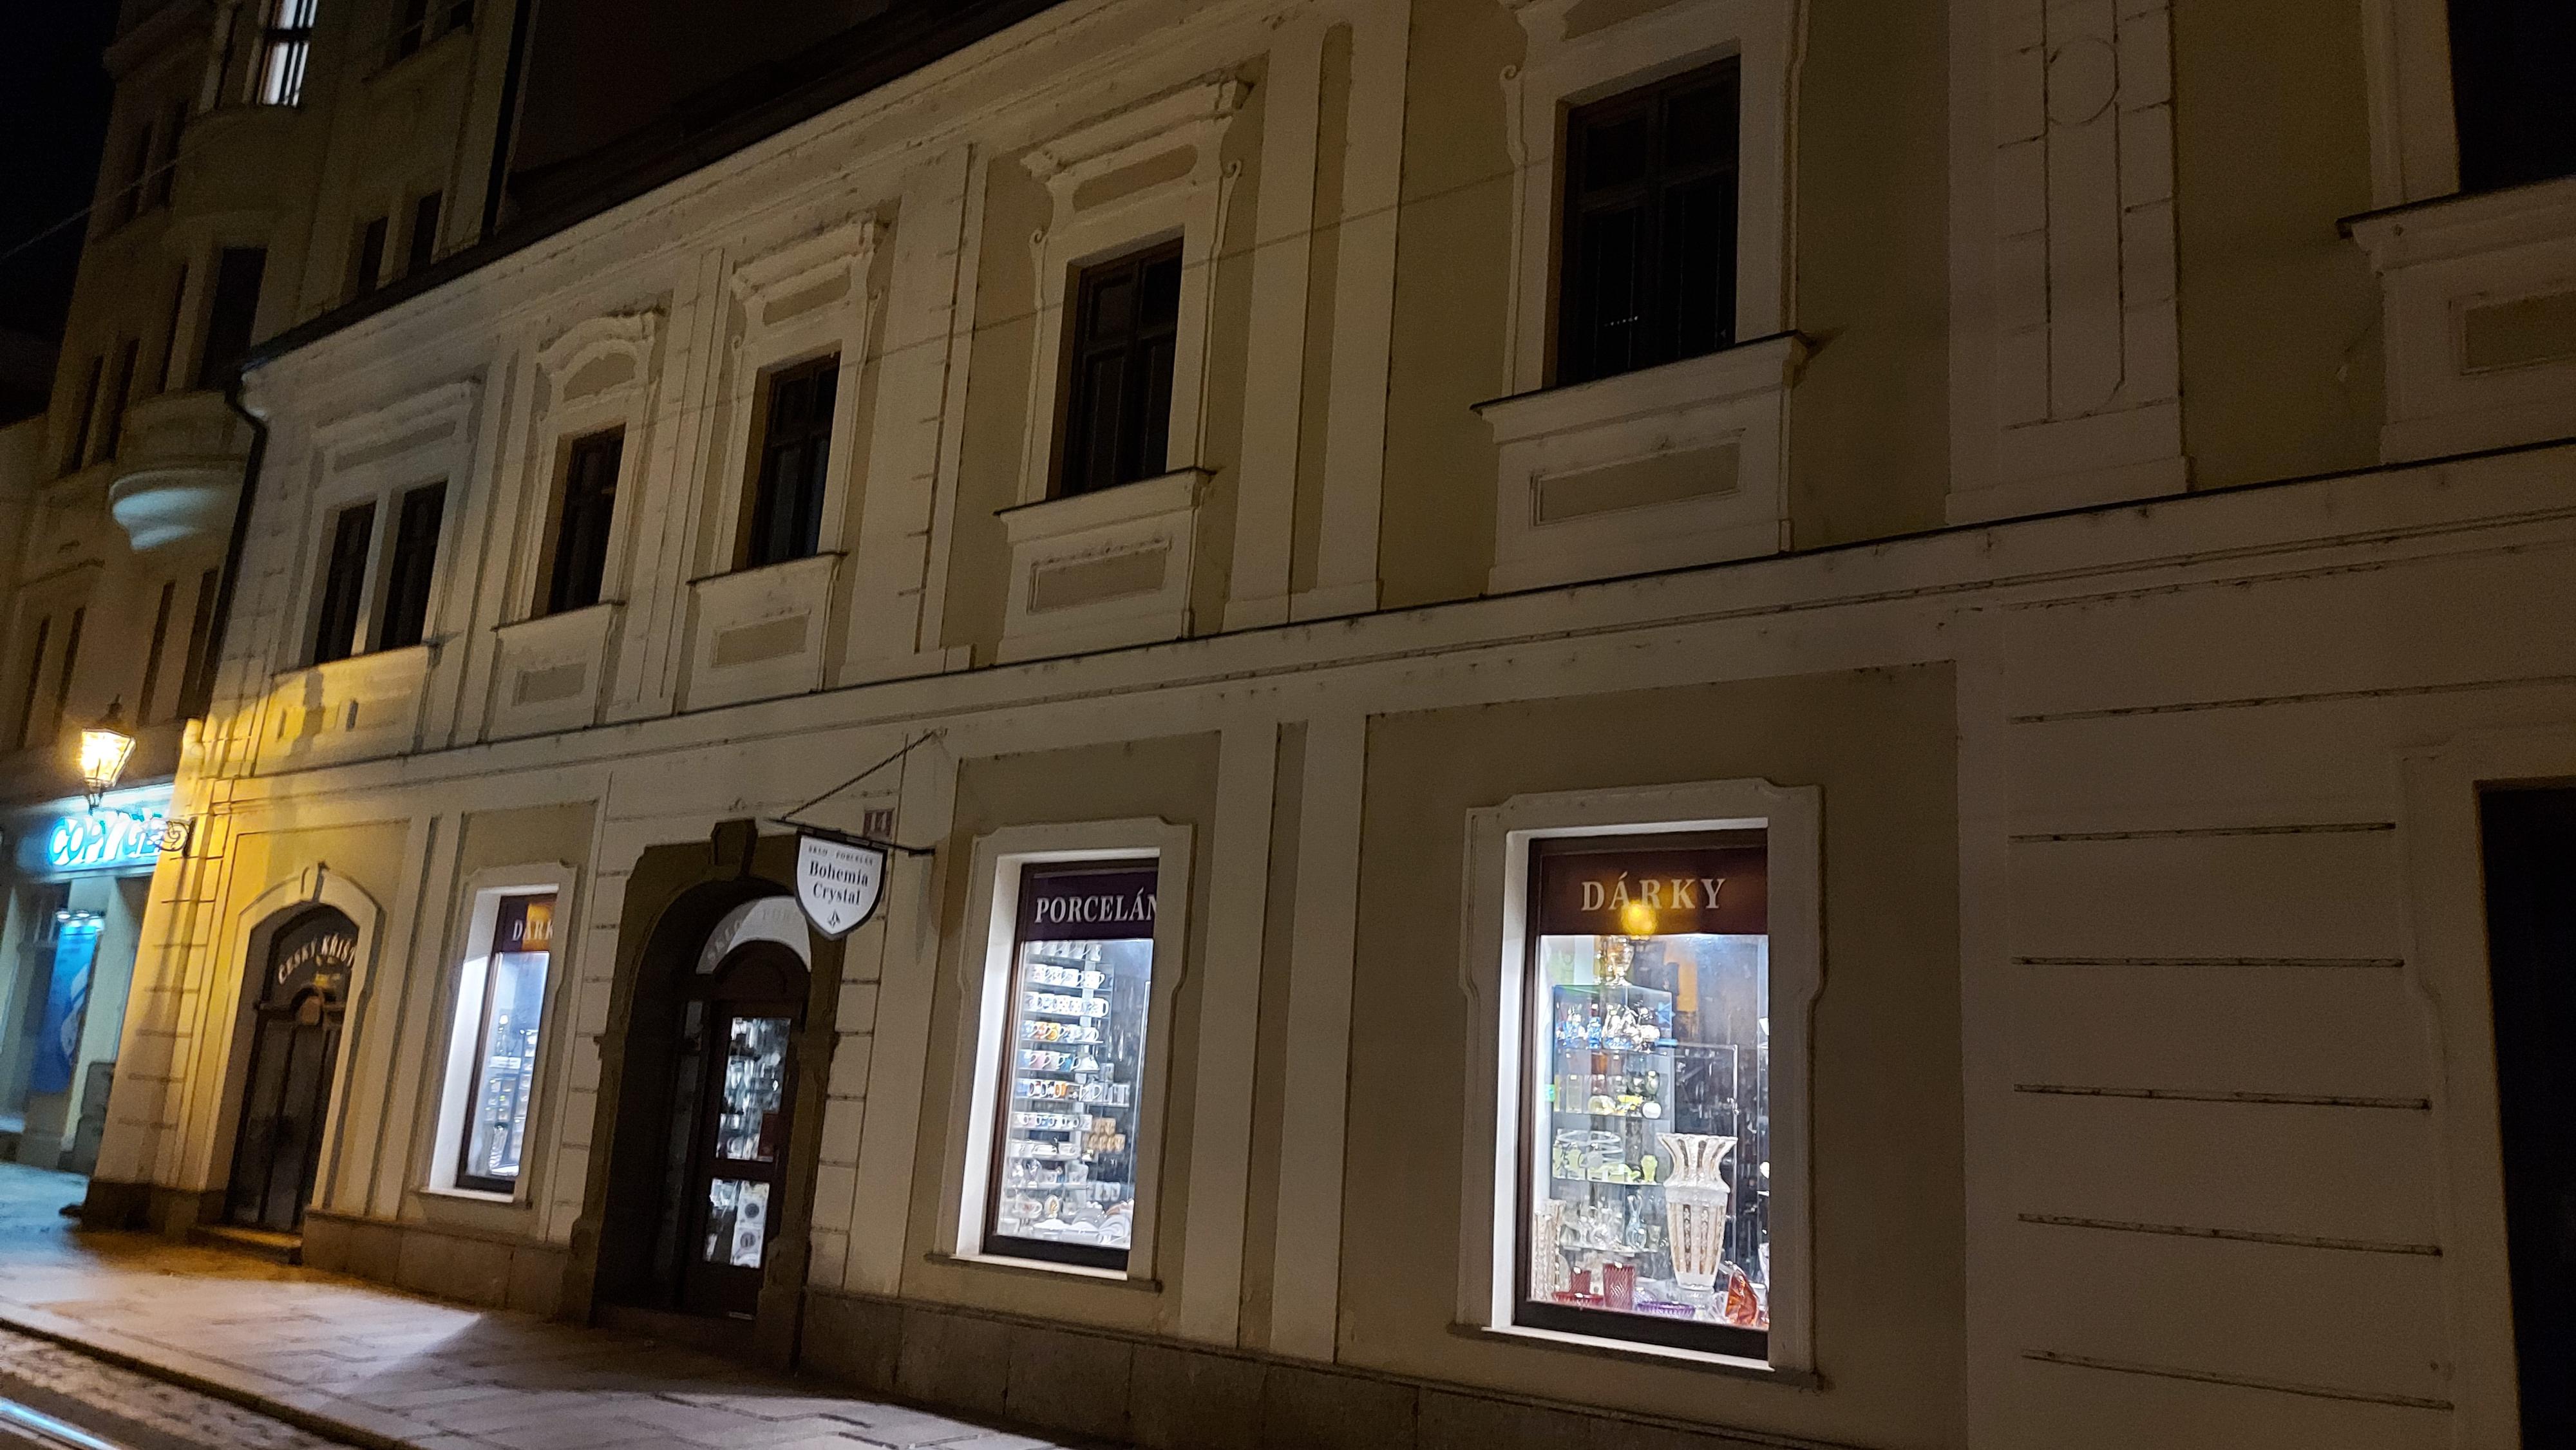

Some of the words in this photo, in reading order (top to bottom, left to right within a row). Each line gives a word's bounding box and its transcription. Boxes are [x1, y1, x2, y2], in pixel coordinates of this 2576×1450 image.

[810, 861, 868, 887] Bohemia
[813, 881, 860, 905] Crystal
[1034, 887, 1157, 923] PORCELÁN
[1581, 871, 1727, 911] DÁRKY
